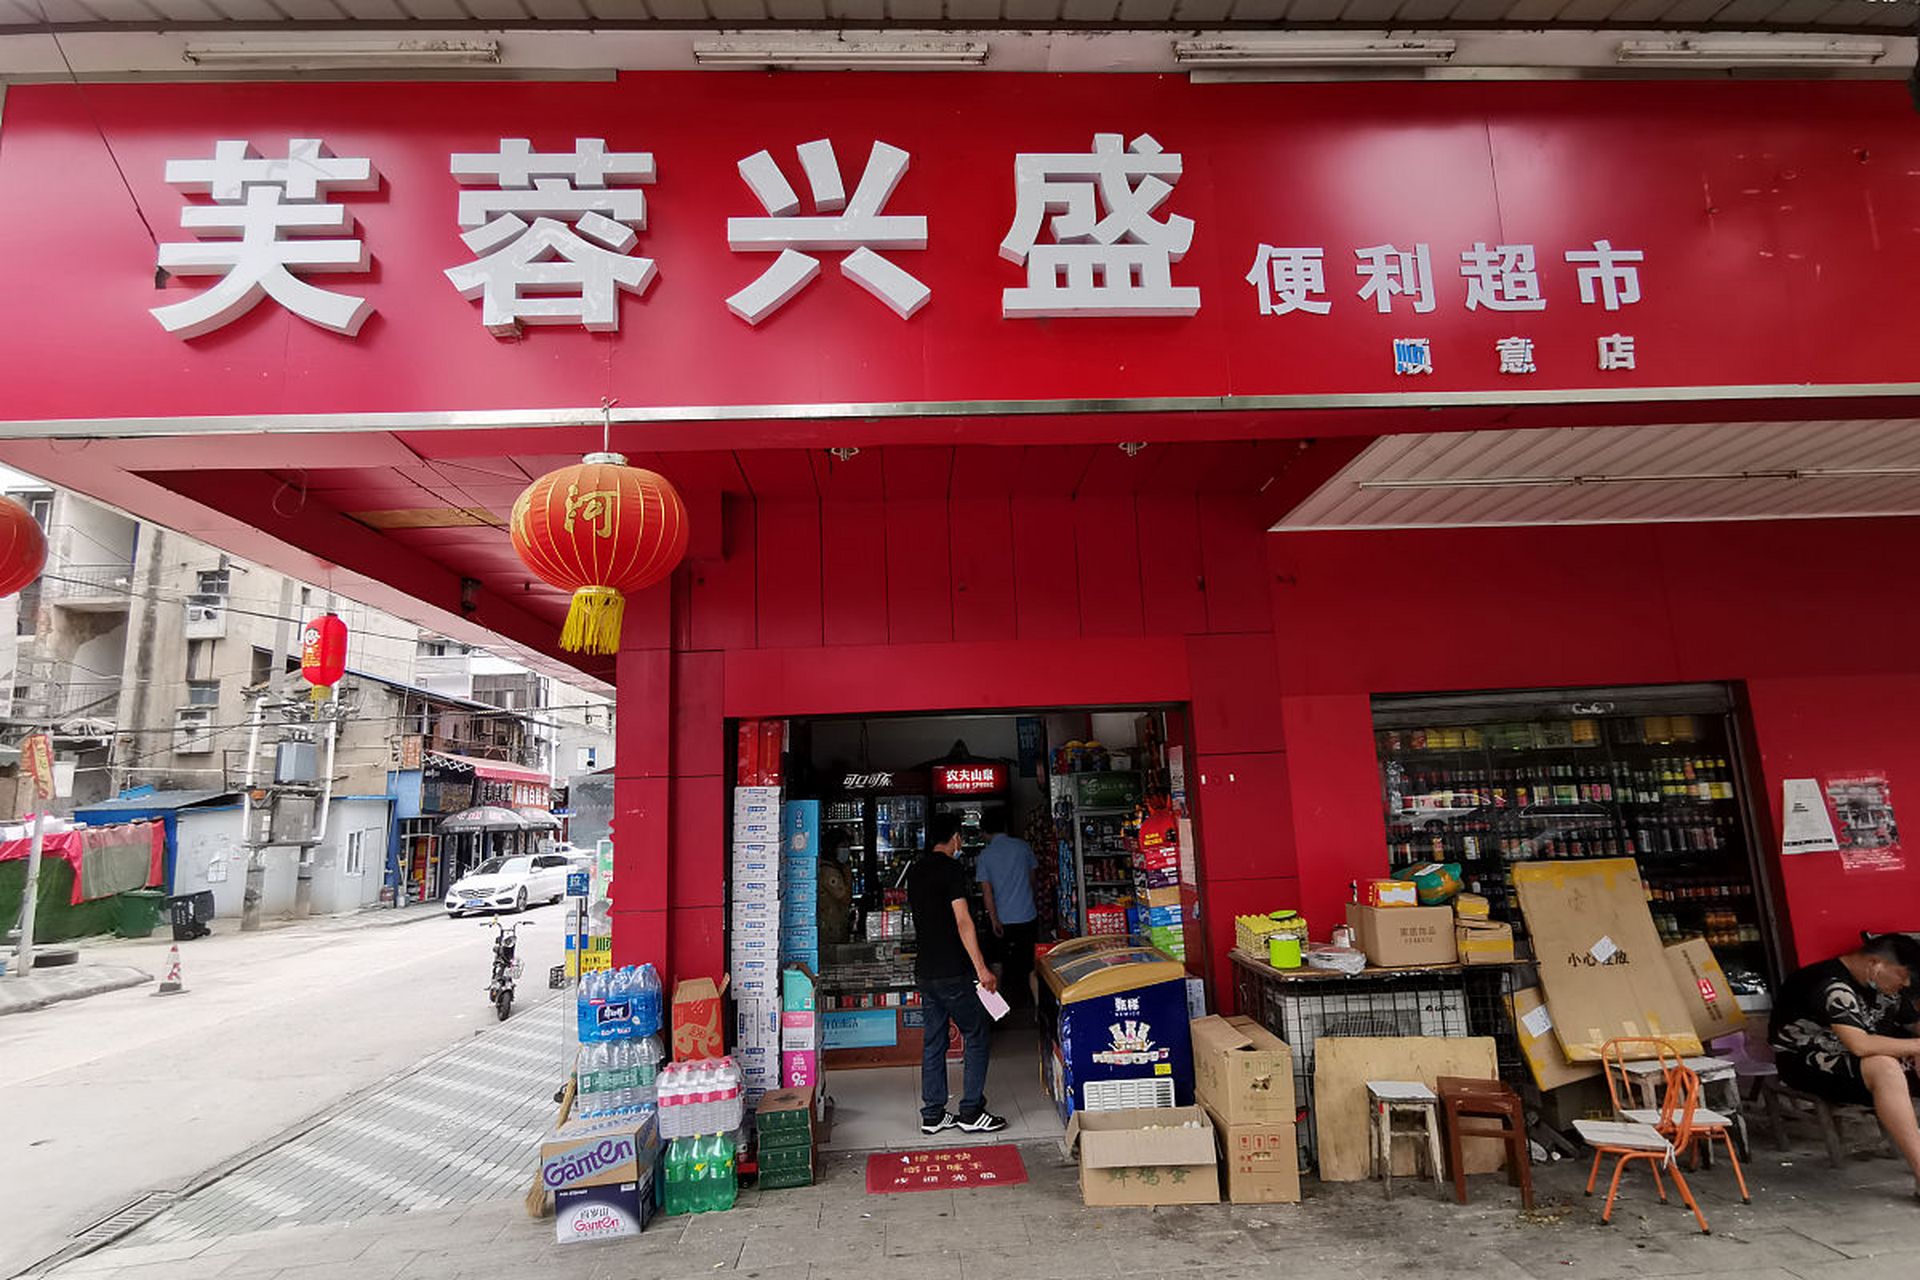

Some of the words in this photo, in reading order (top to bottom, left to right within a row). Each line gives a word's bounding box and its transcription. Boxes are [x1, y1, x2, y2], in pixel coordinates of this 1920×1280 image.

[149, 132, 1202, 341] 芙蓉兴盛
[1246, 240, 1644, 316] 便利超市
[1393, 333, 1636, 376] 顺意店
[843, 772, 895, 789] 可口可乐
[946, 768, 995, 782] 农夫山泉
[1568, 949, 1630, 968] 小心放
